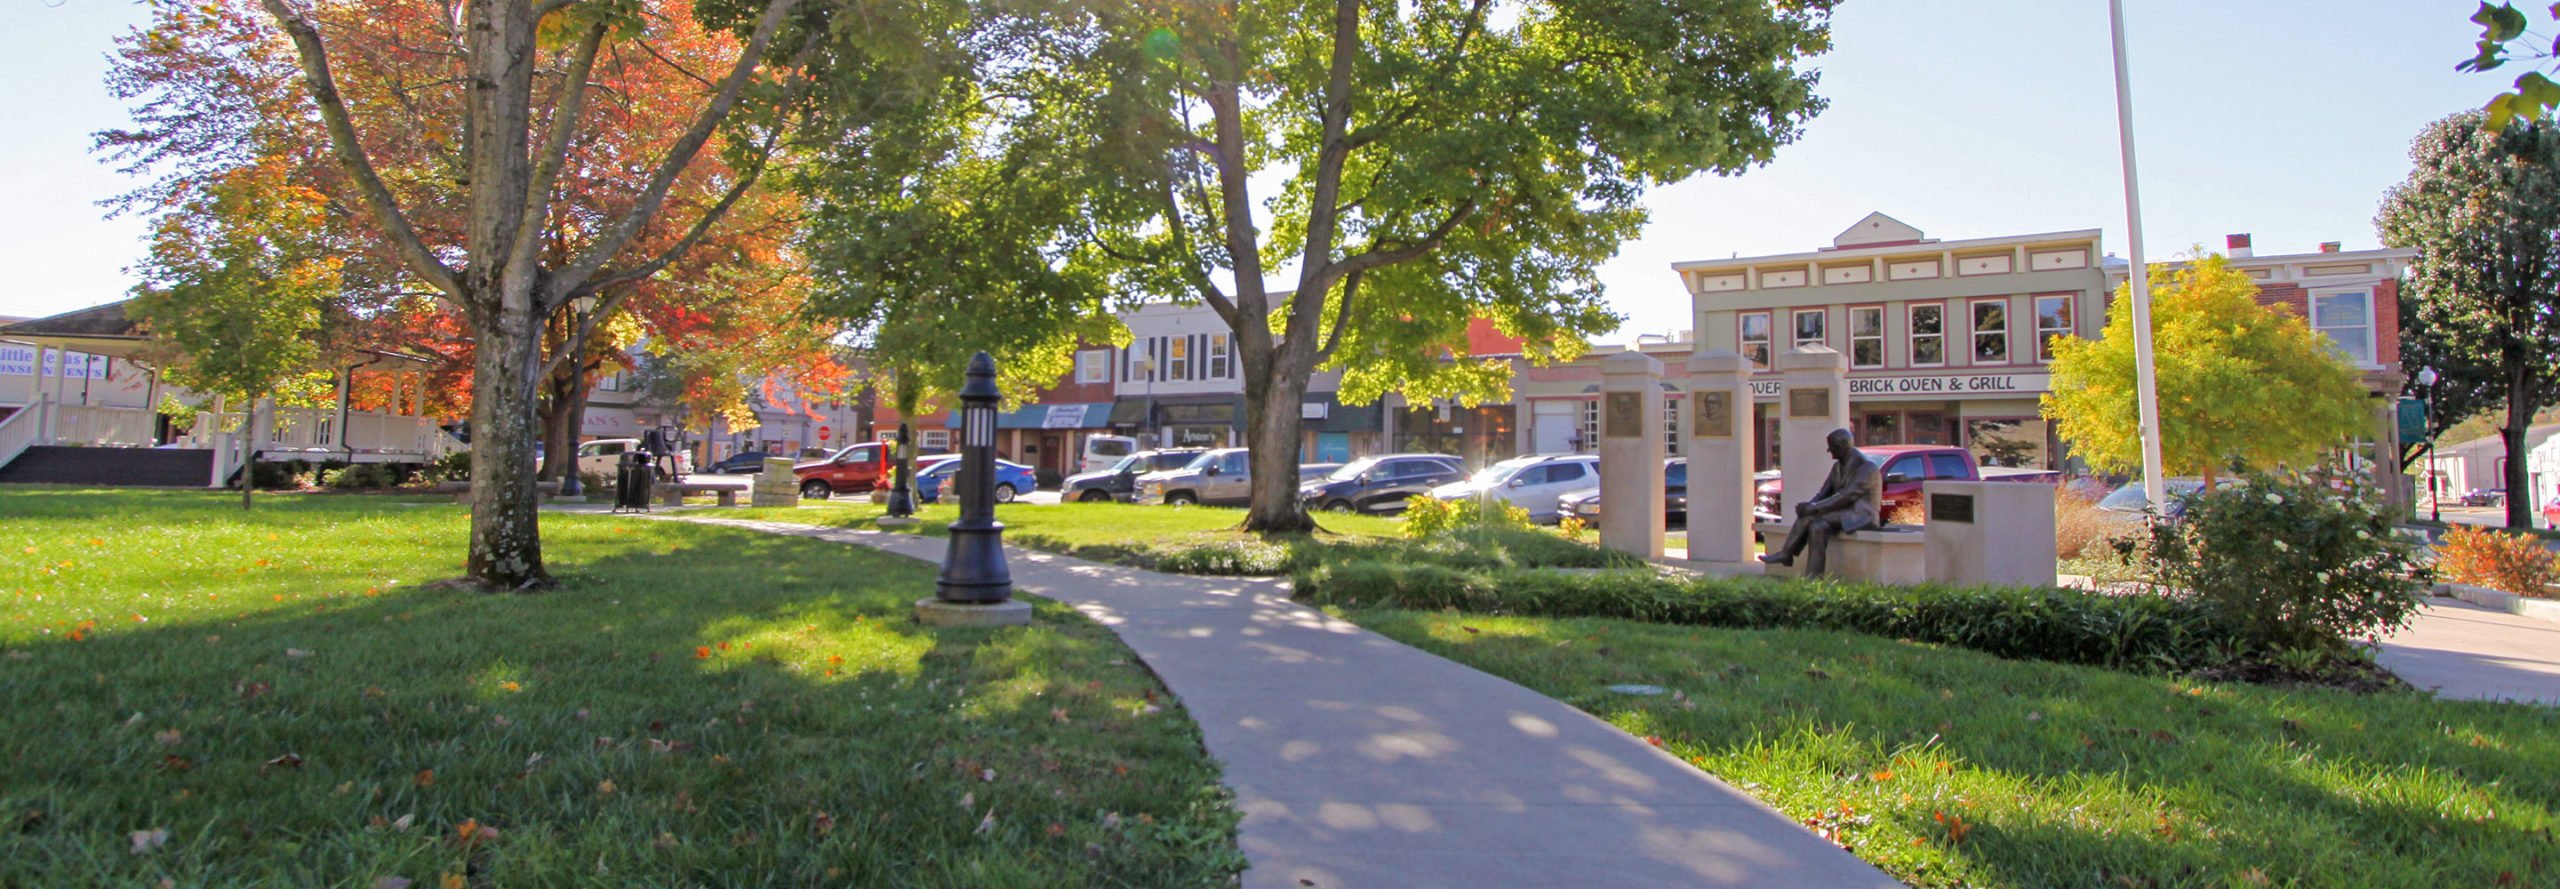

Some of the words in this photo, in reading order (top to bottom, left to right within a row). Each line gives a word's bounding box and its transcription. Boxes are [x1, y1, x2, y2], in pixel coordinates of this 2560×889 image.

[0, 348, 33, 362] ittle
[1850, 379, 1894, 393] BRICK
[1900, 378, 1942, 392] OVEN
[1949, 377, 1963, 391] &
[1968, 376, 2015, 390] GRILL
